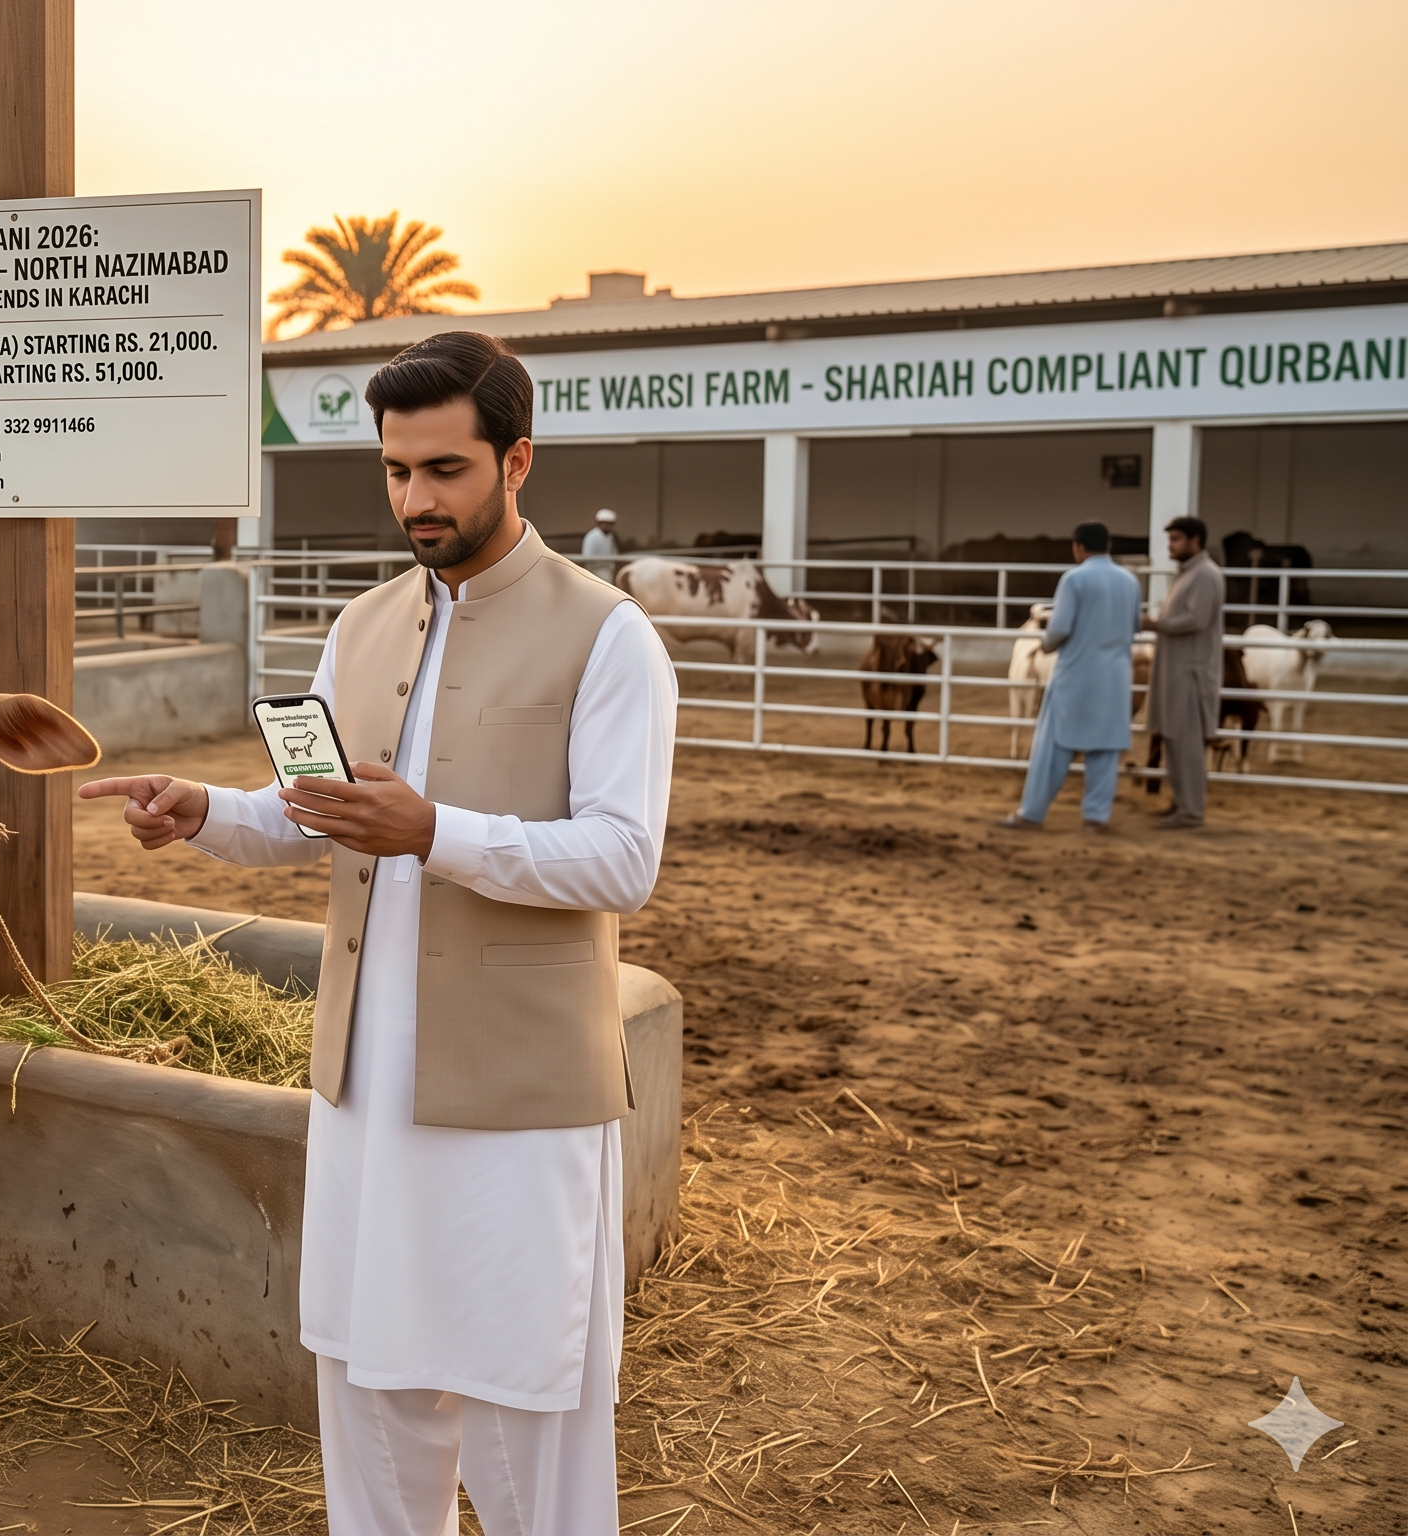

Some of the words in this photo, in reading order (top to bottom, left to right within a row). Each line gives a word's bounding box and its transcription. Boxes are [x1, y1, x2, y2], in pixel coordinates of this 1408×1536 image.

[37, 223, 99, 250] 2026:
[14, 255, 87, 282] NORTH
[95, 249, 229, 279] NAZIMABAD
[45, 287, 63, 308] IN
[69, 284, 149, 307] KARACHI
[23, 333, 110, 356] STARTING
[115, 332, 144, 353] RS.
[148, 330, 218, 355] 21,000.
[62, 362, 90, 383] RS.
[95, 360, 164, 385] 51,000.
[537, 377, 591, 413] THE
[599, 373, 694, 411] WARSI
[705, 368, 790, 407] FARM
[824, 358, 974, 403] SHARIAH
[987, 346, 1208, 396] COMPLIANT
[1219, 336, 1408, 390] QURBANI
[3, 418, 30, 435] 332
[33, 416, 95, 434] 9911466
